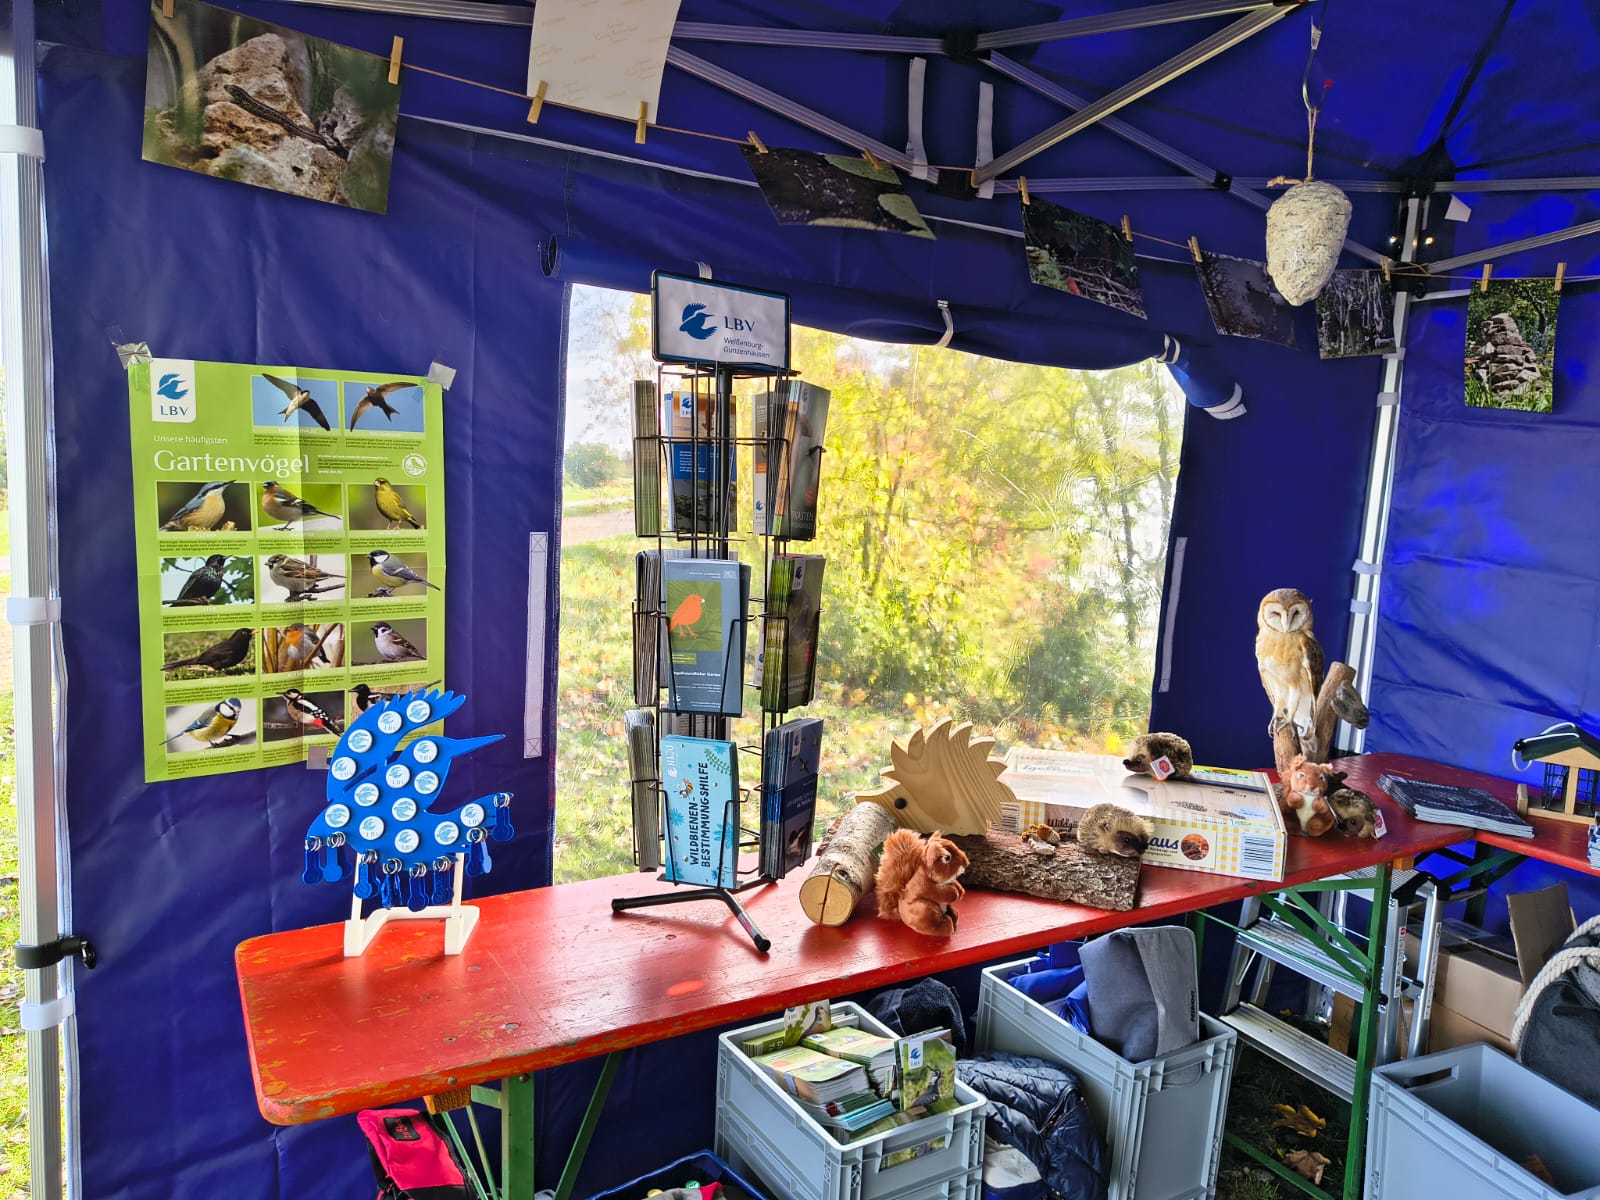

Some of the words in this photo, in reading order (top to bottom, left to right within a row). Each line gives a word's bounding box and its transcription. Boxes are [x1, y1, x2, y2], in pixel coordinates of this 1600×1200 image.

[724, 315, 756, 333] LBV
[723, 336, 764, 351] Weißenburg-
[723, 346, 770, 359] Gunzenhausen
[160, 404, 189, 417] LBV
[153, 434, 183, 443] Unsere
[185, 434, 228, 446] häufigsten
[153, 448, 310, 479] Gartenvögel
[698, 762, 711, 867] BESTIMMUNGSHILFE
[688, 796, 700, 865] WILDBIENEN-
